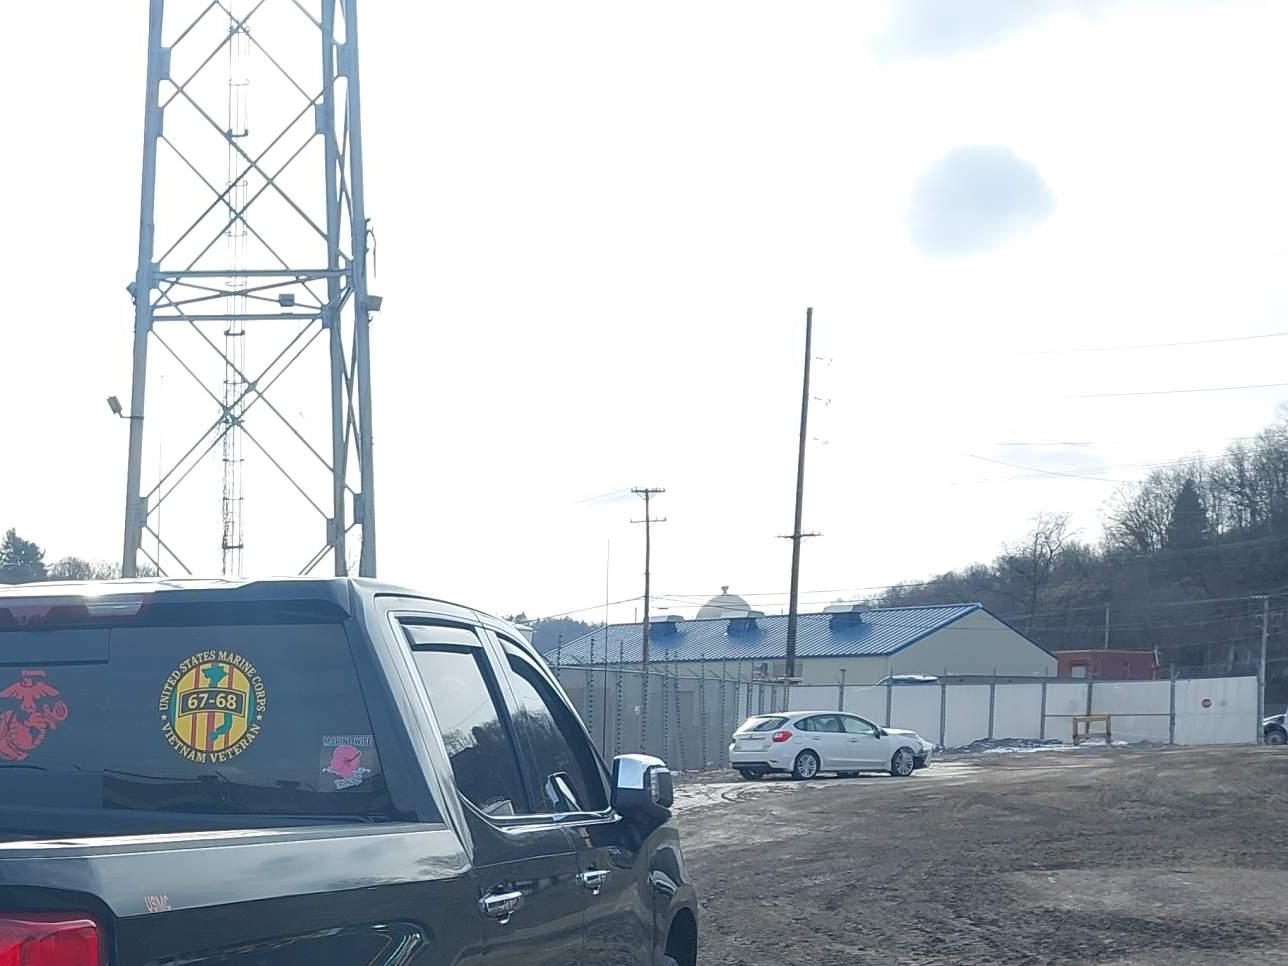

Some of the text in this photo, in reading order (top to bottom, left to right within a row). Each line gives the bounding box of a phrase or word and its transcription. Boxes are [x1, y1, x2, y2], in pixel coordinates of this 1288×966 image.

[159, 650, 267, 713] UNITED STATES MARINE CORPS
[187, 693, 237, 709] 67-68
[161, 722, 262, 763] VIETNAM VETERAN
[144, 895, 171, 912] USMC
